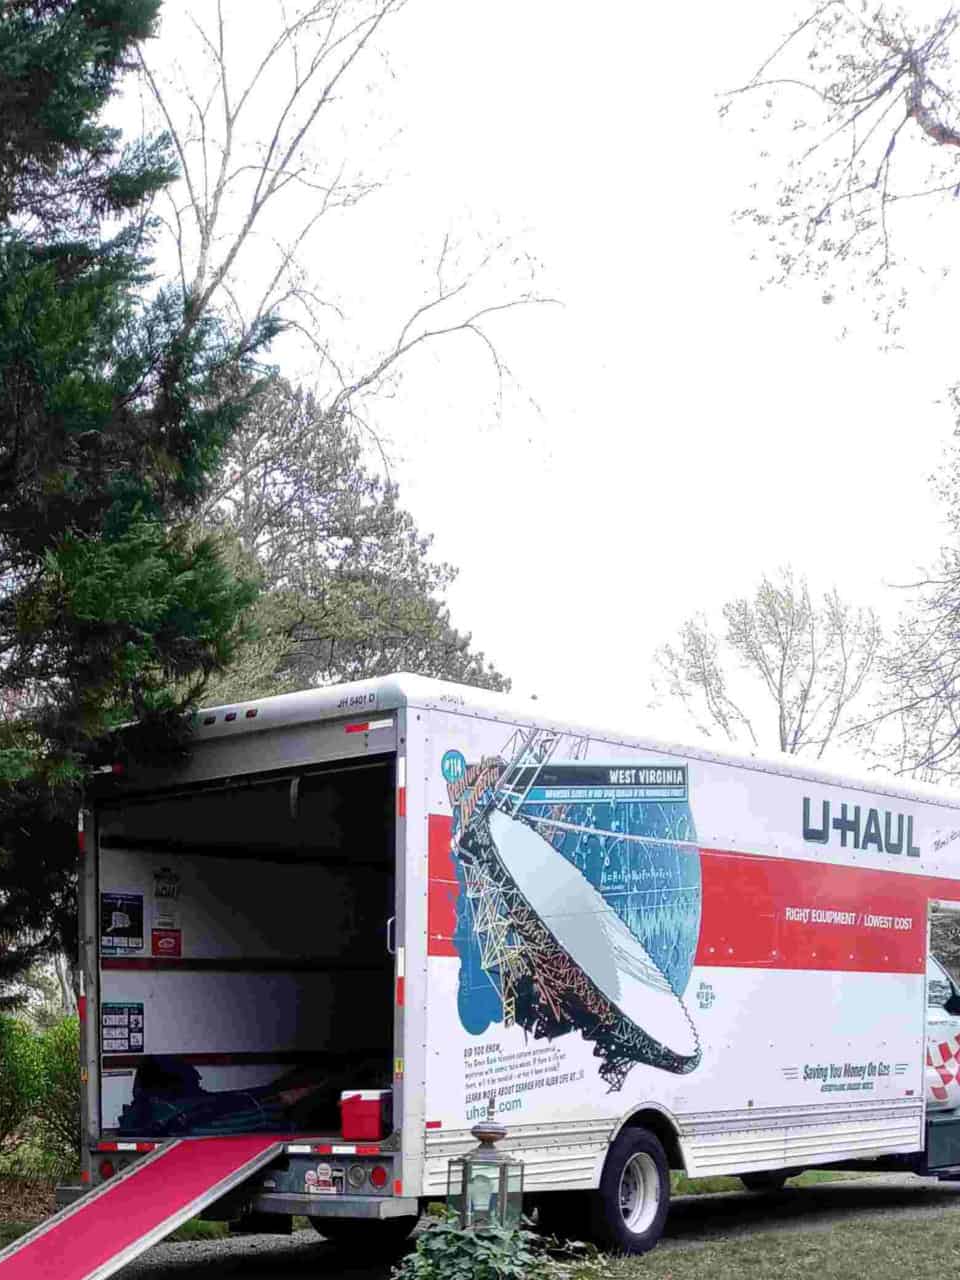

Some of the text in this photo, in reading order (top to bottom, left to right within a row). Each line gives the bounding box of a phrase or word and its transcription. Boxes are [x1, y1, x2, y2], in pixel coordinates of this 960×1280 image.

[610, 769, 684, 785] WEST VIRGINIA
[803, 797, 921, 858] U-HAUL
[786, 907, 809, 923] RIGHT
[811, 909, 856, 926] EQUIPMENT
[864, 915, 892, 929] LOWEST
[895, 918, 913, 930] COST
[803, 1064, 828, 1082] Saving
[830, 1063, 842, 1079] You
[843, 1062, 866, 1080] Money
[867, 1062, 876, 1077] On
